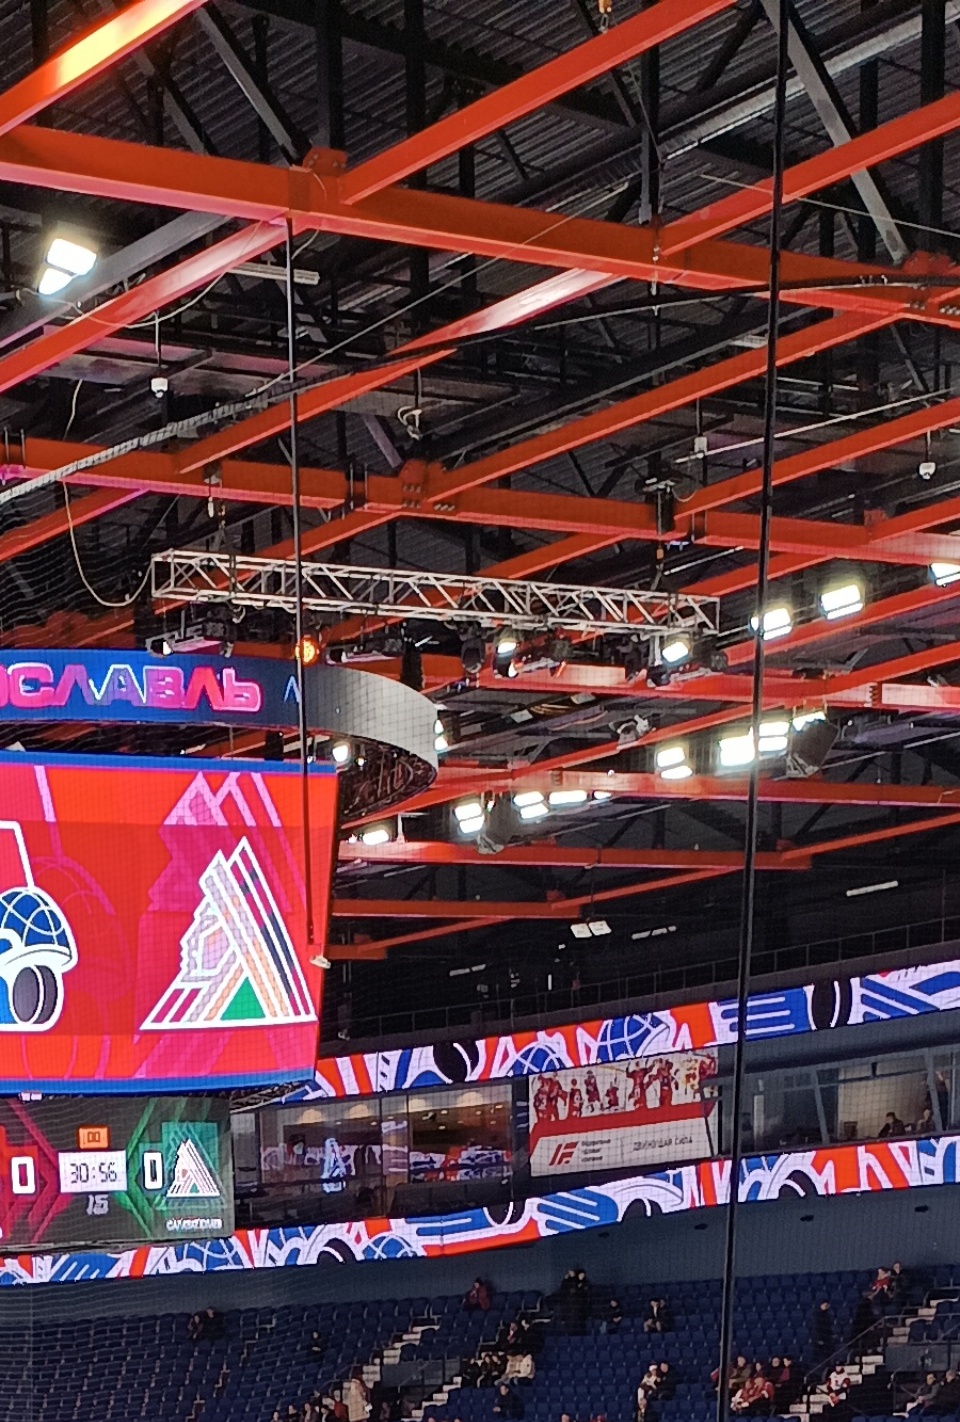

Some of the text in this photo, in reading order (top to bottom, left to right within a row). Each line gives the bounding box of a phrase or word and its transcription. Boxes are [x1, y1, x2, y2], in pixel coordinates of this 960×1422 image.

[11, 1155, 36, 1194] 0
[70, 1161, 117, 1184] 30:56
[143, 1152, 163, 1190] 0
